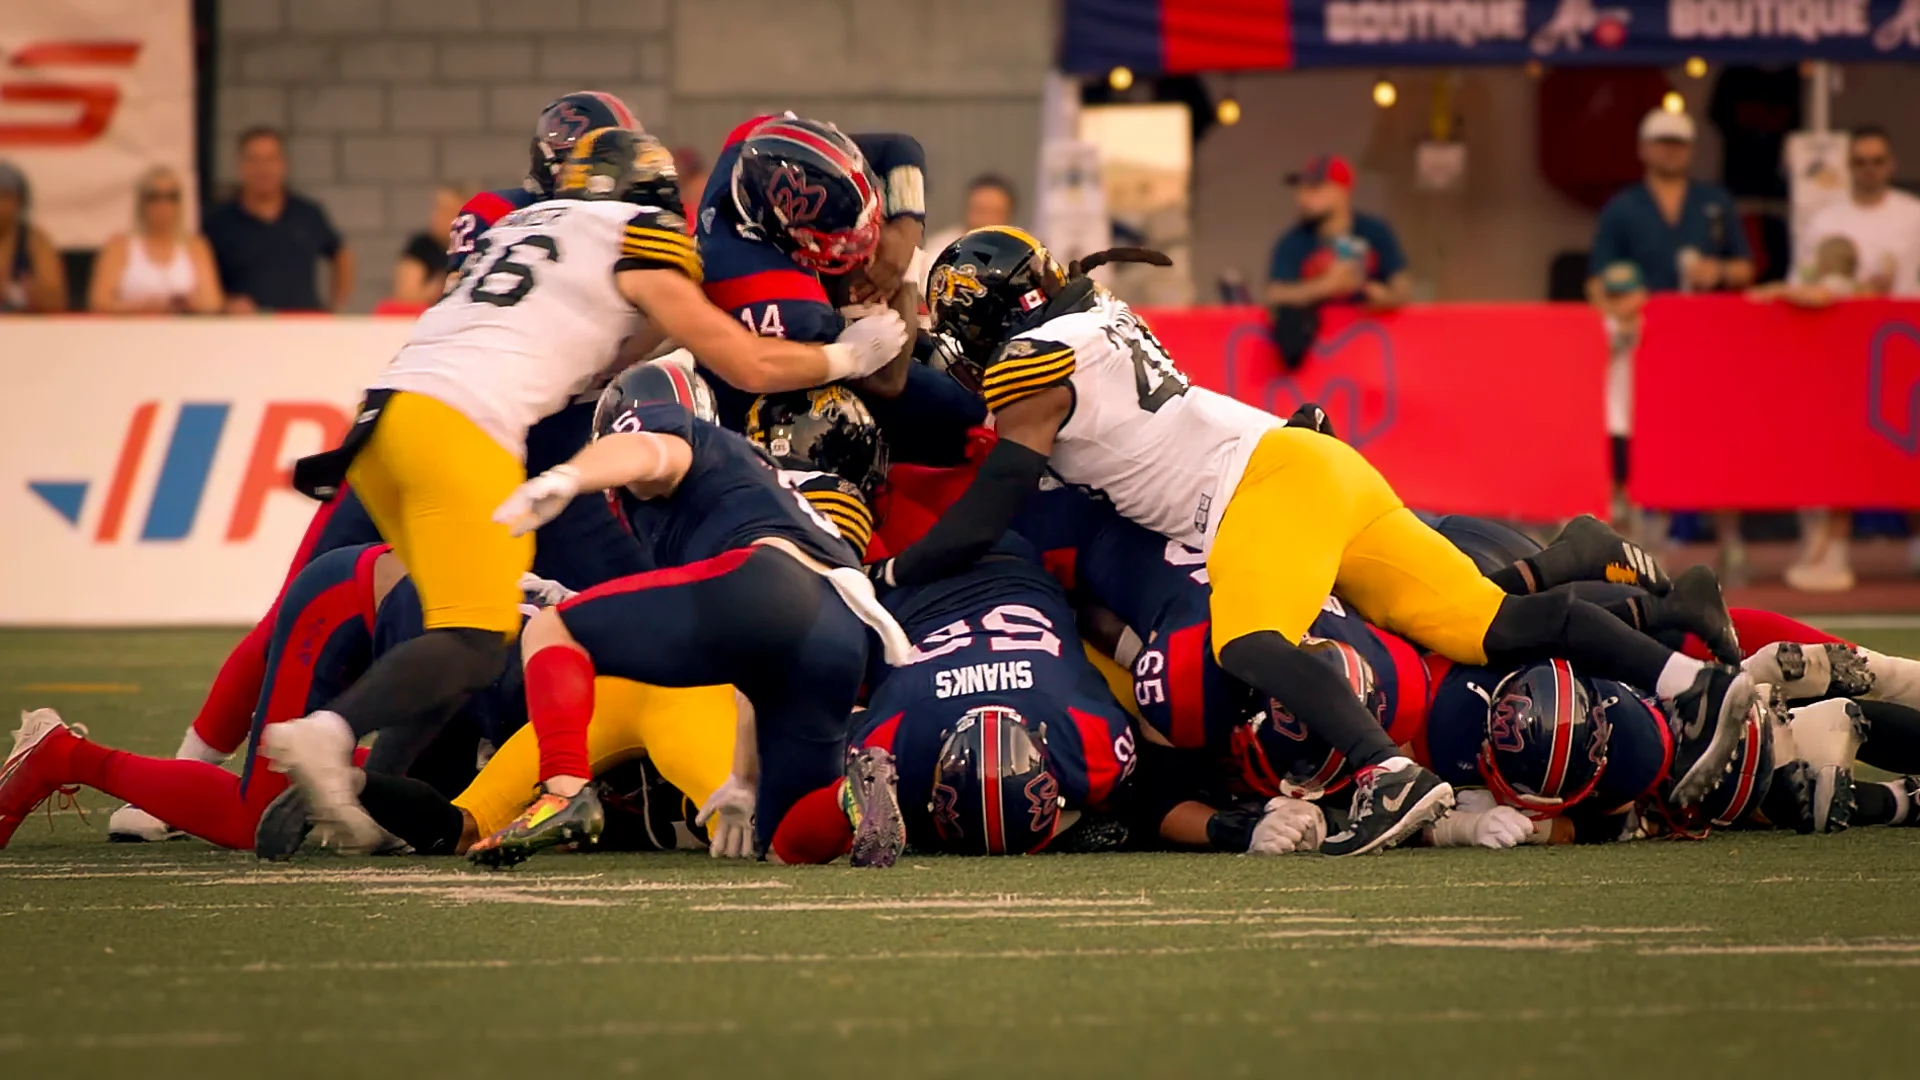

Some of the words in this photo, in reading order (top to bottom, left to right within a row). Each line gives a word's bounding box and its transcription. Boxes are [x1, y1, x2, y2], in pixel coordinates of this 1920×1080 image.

[1325, 0, 1524, 46] BOUTIQUE
[1669, 0, 1867, 43] BOUTIQUE
[741, 304, 784, 339] 14
[935, 660, 1034, 699] SHANKS
[1135, 650, 1166, 706] 65
